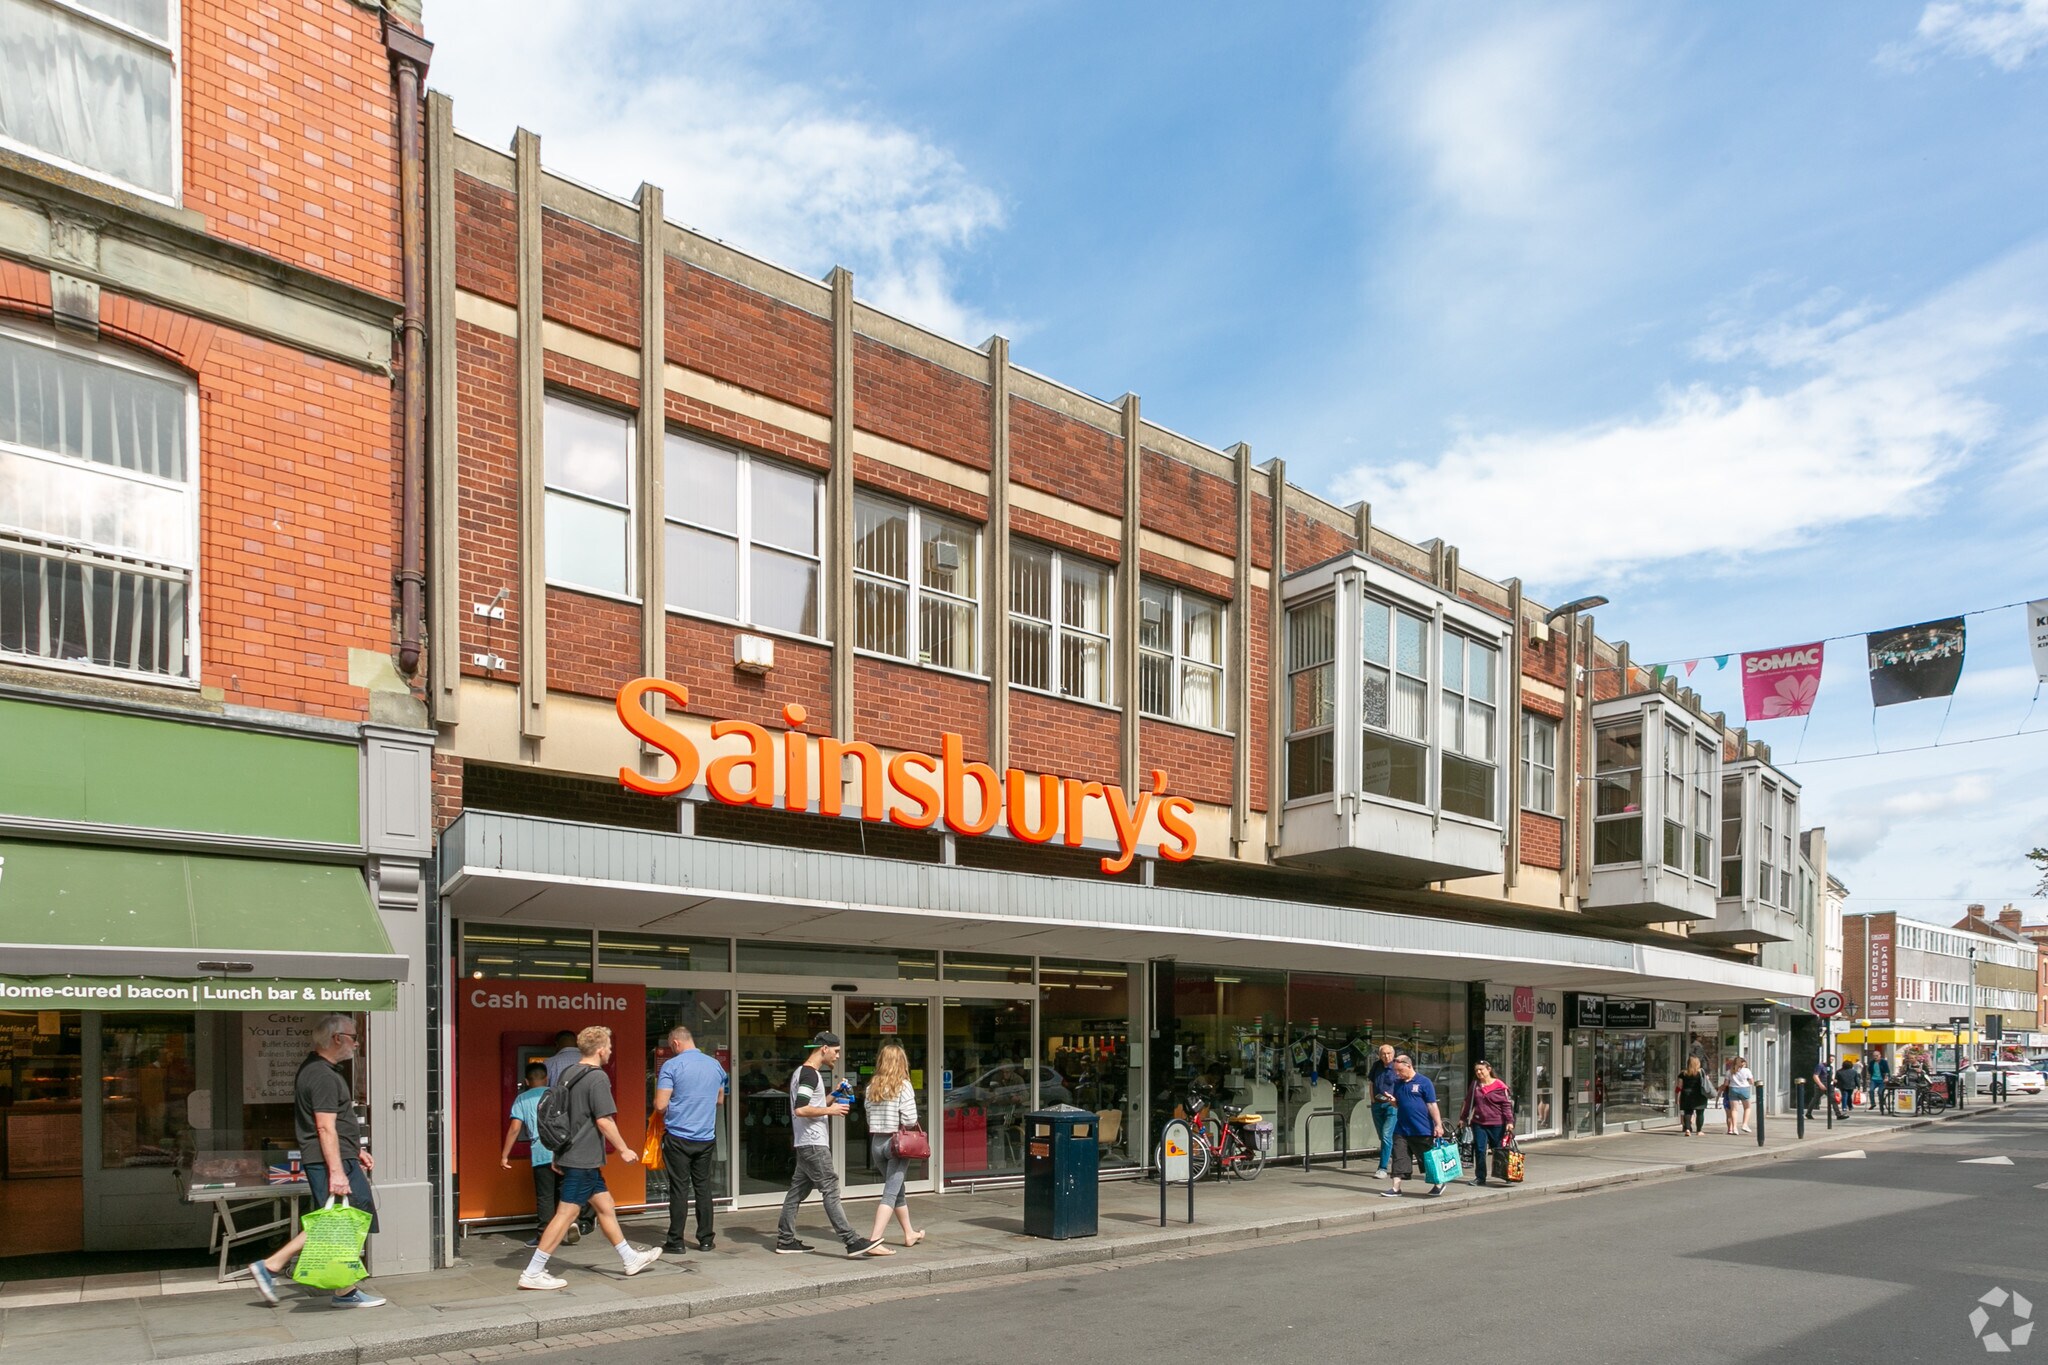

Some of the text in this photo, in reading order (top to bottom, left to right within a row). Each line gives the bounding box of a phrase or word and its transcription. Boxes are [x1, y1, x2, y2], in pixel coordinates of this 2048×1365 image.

[1745, 648, 1819, 673] SoMAC
[616, 676, 1197, 874] Sainsbury's
[128, 984, 189, 999] bacon
[204, 986, 263, 1000] Lunch
[268, 986, 298, 1000] bar
[302, 987, 316, 1001] &
[321, 987, 372, 1001] buffet
[471, 989, 628, 1011] Cash machine
[1516, 995, 1535, 1014] SALE
[1537, 997, 1556, 1020] shop
[1816, 997, 1840, 1009] 30
[268, 1014, 305, 1023] Cater
[249, 1026, 280, 1036] Your
